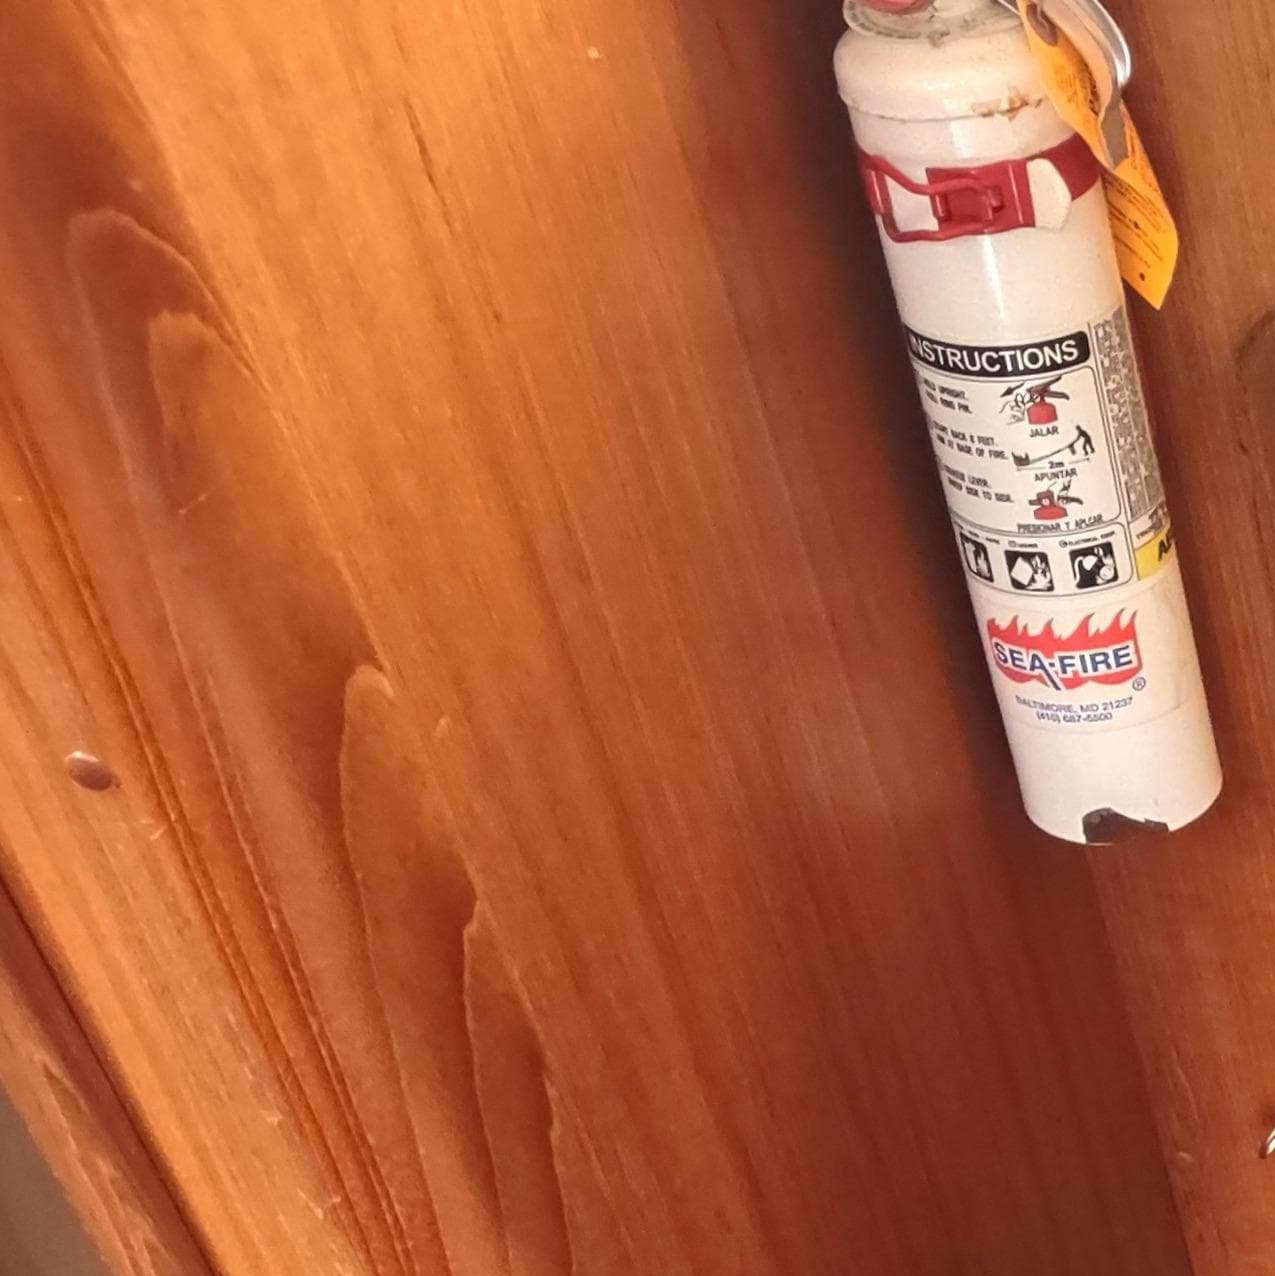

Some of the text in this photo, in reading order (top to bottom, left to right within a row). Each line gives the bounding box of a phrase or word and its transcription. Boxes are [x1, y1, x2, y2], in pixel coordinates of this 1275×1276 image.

[1029, 426, 1059, 438] JALAR
[1049, 461, 1064, 469] 2m
[1035, 468, 1078, 482] APUNTAR
[993, 641, 1133, 691] SEA-FIRE
[1080, 704, 1099, 713] MD
